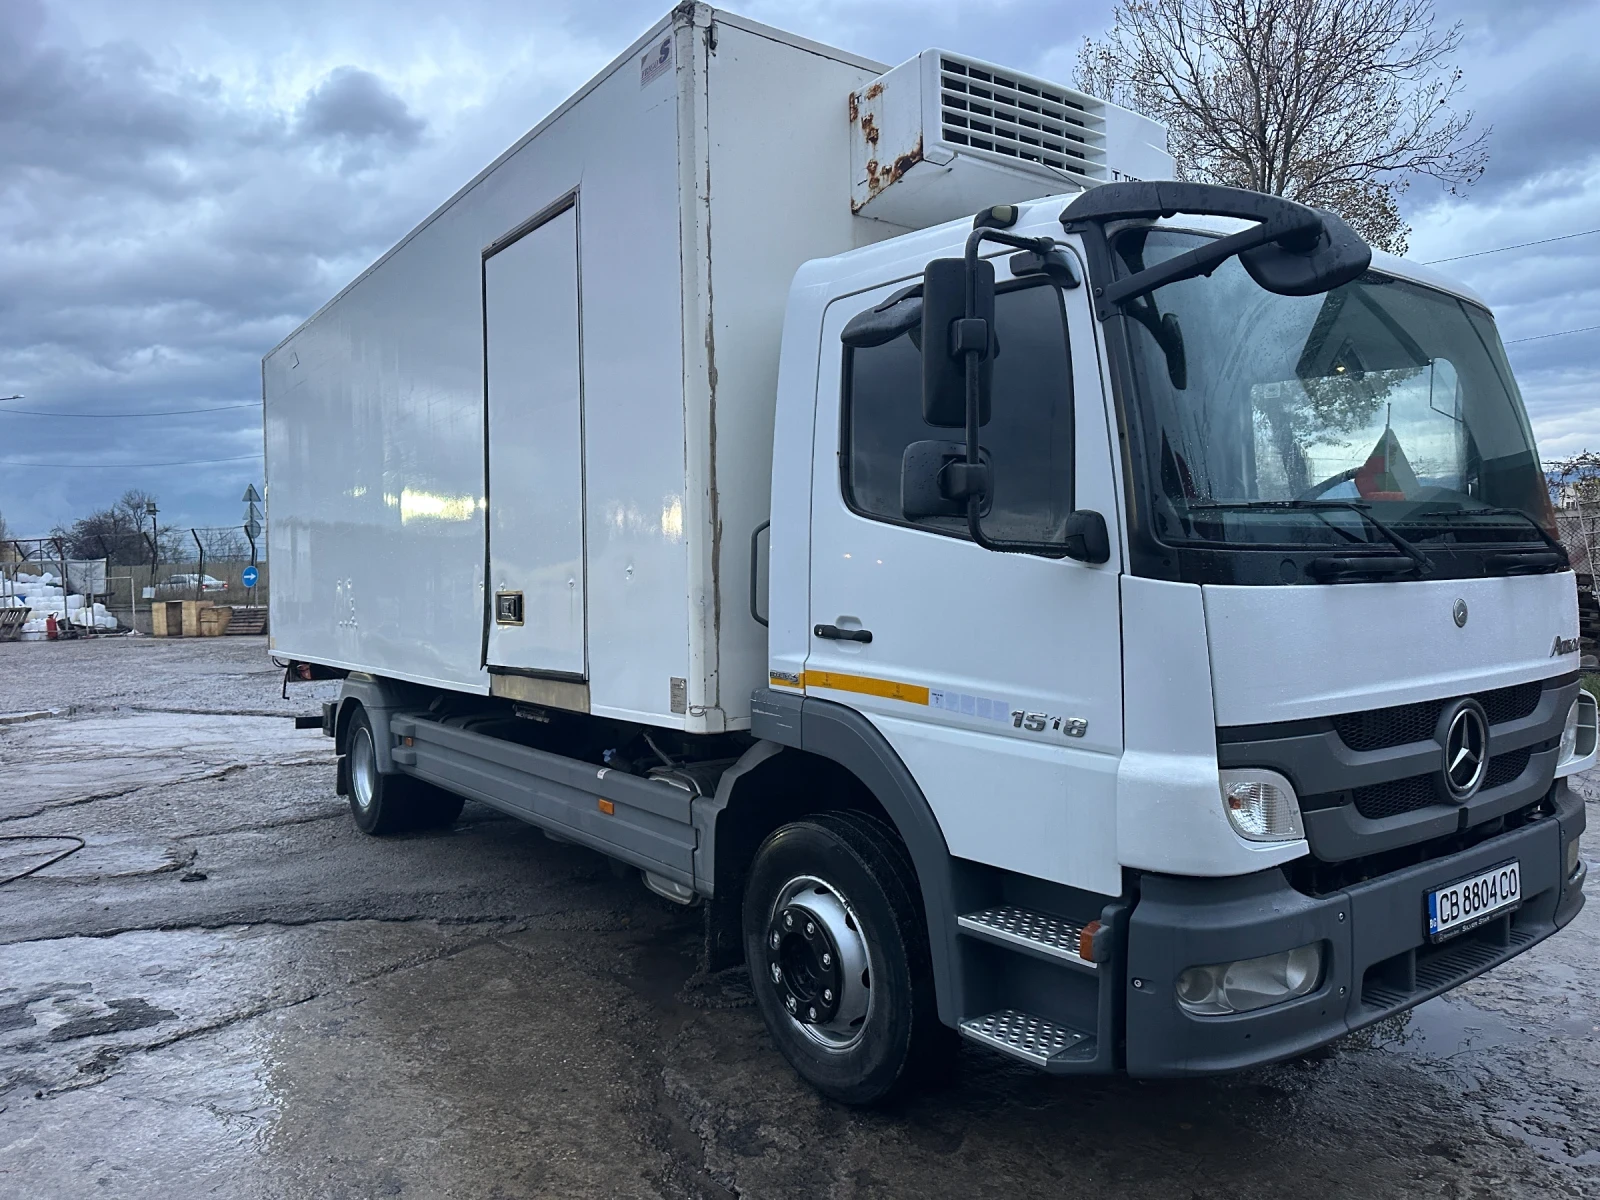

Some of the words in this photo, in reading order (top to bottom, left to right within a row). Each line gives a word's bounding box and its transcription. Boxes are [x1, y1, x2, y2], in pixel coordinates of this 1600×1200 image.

[1011, 709, 1089, 738] 1518
[1440, 889, 1460, 924] CB
[1463, 875, 1498, 915] 8804
[1500, 868, 1518, 900] CO
